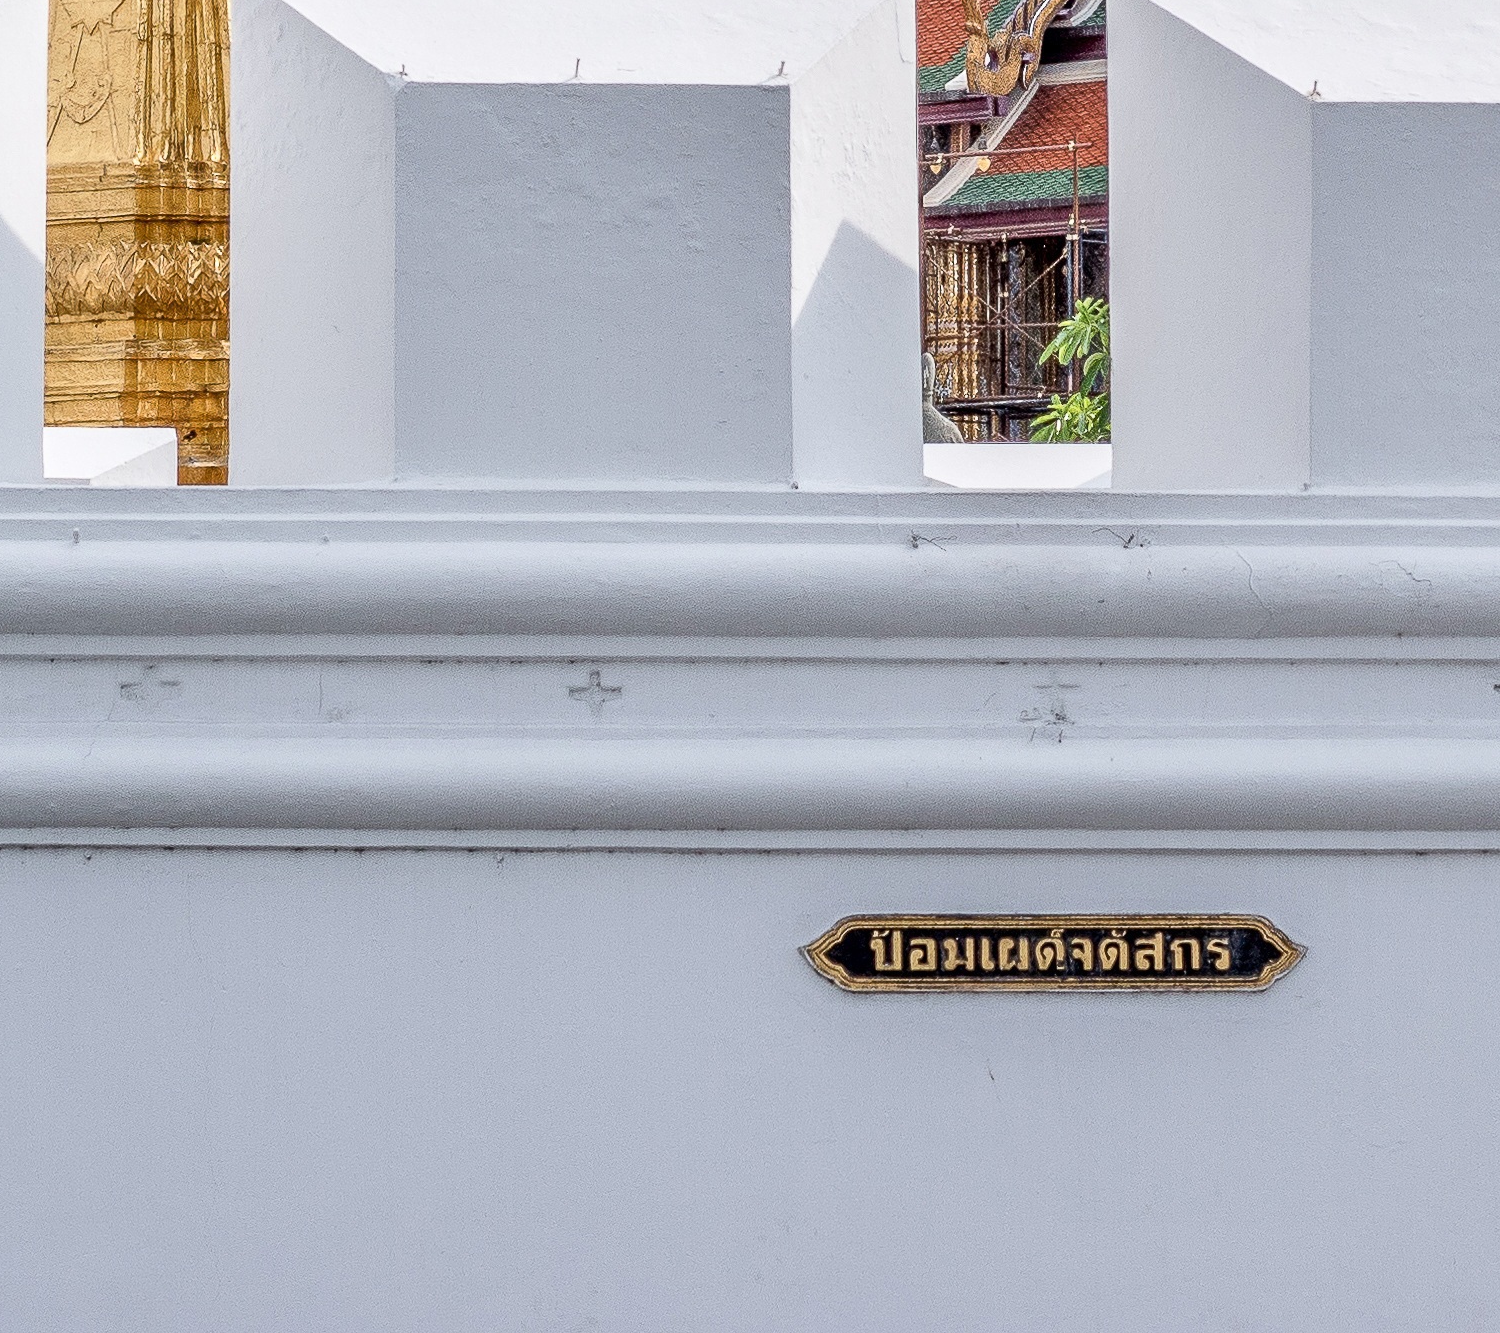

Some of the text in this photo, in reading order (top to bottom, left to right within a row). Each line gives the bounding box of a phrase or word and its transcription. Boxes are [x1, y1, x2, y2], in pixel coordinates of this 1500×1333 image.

[870, 929, 1230, 971] ป้อมเผด็จดัสกร
